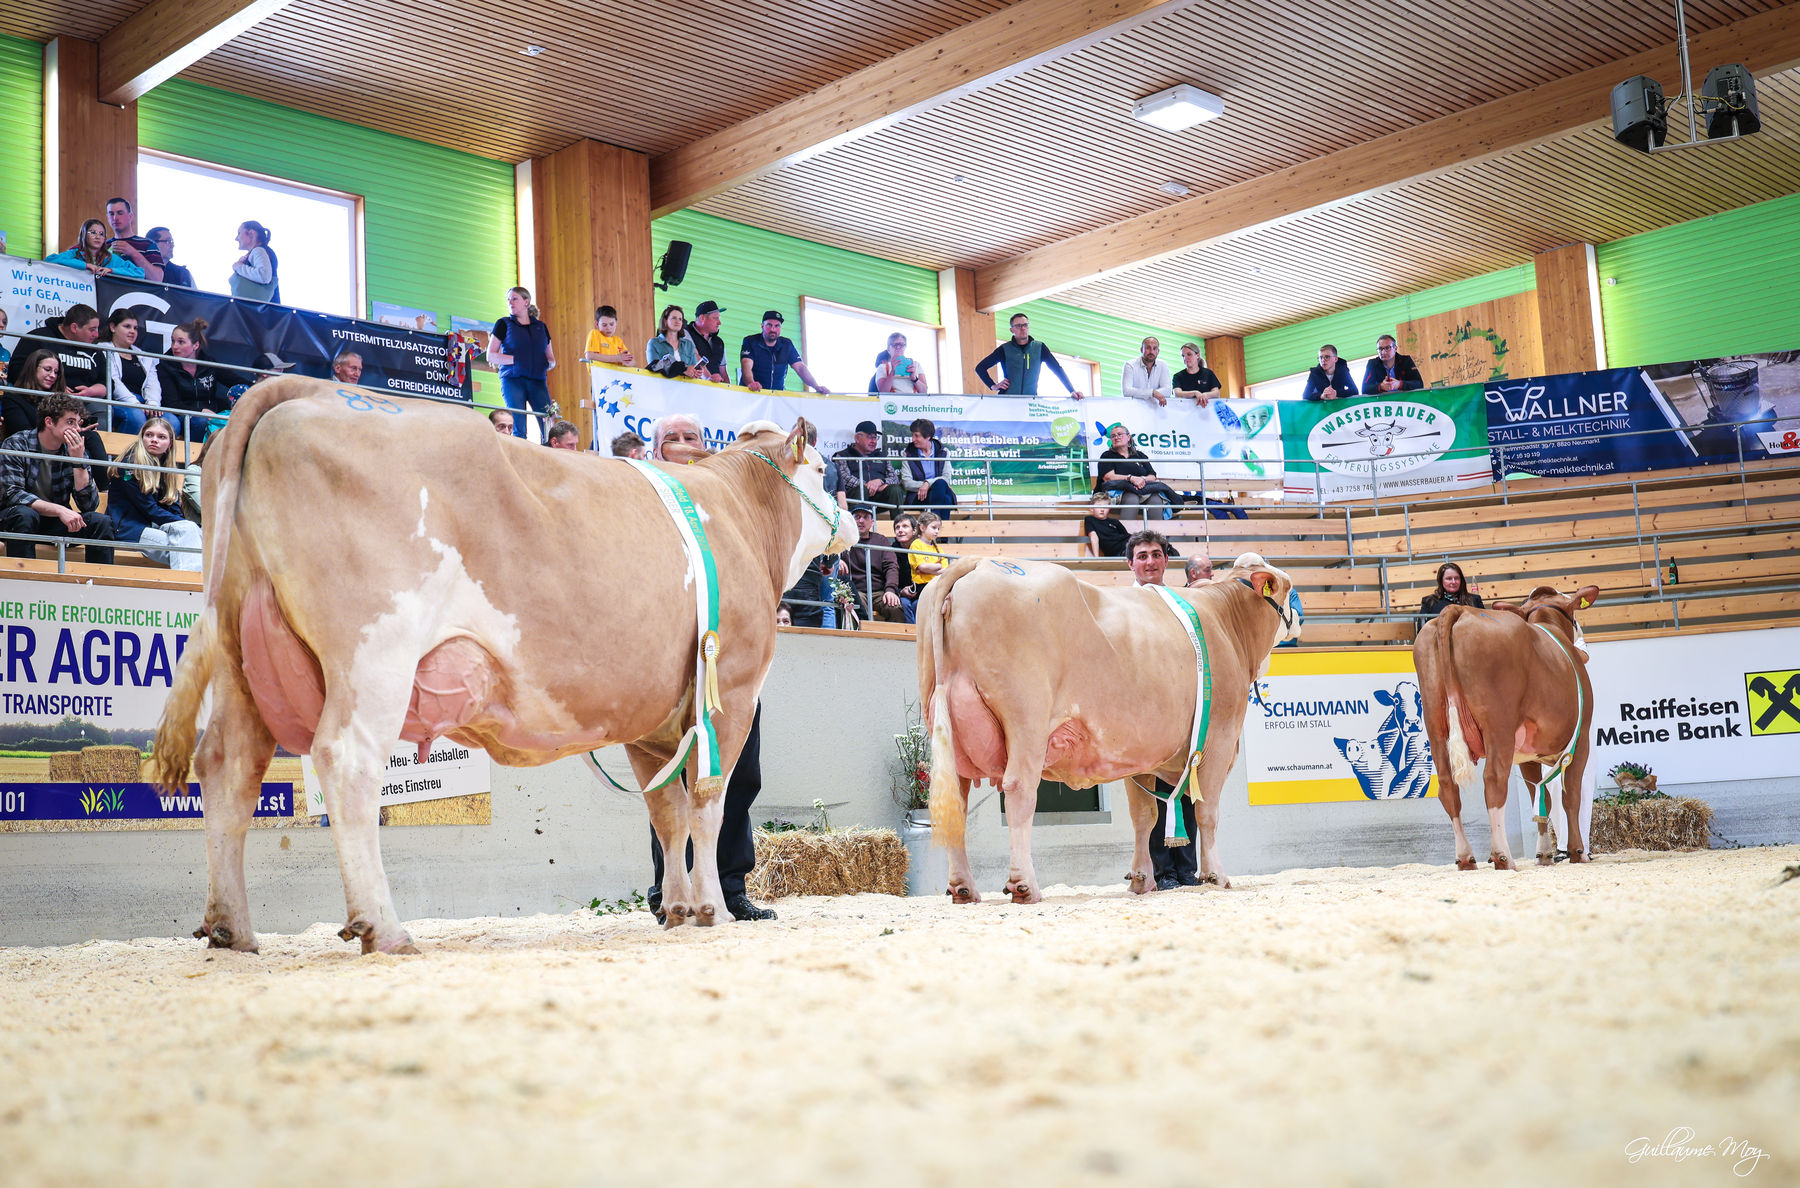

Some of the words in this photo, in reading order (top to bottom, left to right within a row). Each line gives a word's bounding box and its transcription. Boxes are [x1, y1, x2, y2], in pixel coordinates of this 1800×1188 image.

[12, 269, 33, 282] Wir
[36, 275, 93, 292] vertrauen
[12, 286, 33, 297] auf
[36, 289, 61, 302] GEA
[35, 303, 67, 317] Melk
[332, 329, 449, 357] FUTTERMITTELZUSATZSTO
[59, 353, 92, 370] PUMA
[387, 378, 464, 398] GETREIDEHANDEL
[901, 404, 963, 415] Maschinenring
[1484, 386, 1629, 422] WALLNER
[1321, 405, 1437, 435] WASSERBAUER
[1487, 428, 1529, 442] STALL-
[1532, 427, 1541, 438] &
[1543, 418, 1632, 437] MELKTECHNIK
[887, 435, 901, 444] Du
[941, 436, 971, 445] einen
[972, 435, 1019, 445] flexiblen
[1020, 436, 1040, 445] Job
[887, 448, 899, 457] in
[964, 448, 999, 458] Haben
[999, 448, 1021, 458] wir!
[965, 467, 986, 476] unte
[1382, 475, 1455, 489] WWW.WASSERBAUER.AT
[29, 600, 57, 621] FÜR
[62, 605, 162, 627] ERFOLGREICHE
[3, 694, 113, 716] TRANSPORTE
[1264, 700, 1369, 718] SCHAUMANN
[1620, 697, 1740, 722] Raiffeisen
[1264, 720, 1295, 730] ERFOLG
[1297, 720, 1308, 729] IM
[1309, 719, 1332, 729] STALL
[1596, 724, 1670, 746] Meine
[1677, 717, 1743, 741] Bank
[1267, 763, 1333, 772] www.schaumann.at
[381, 783, 404, 796] ertes
[405, 778, 442, 793] Einstreu
